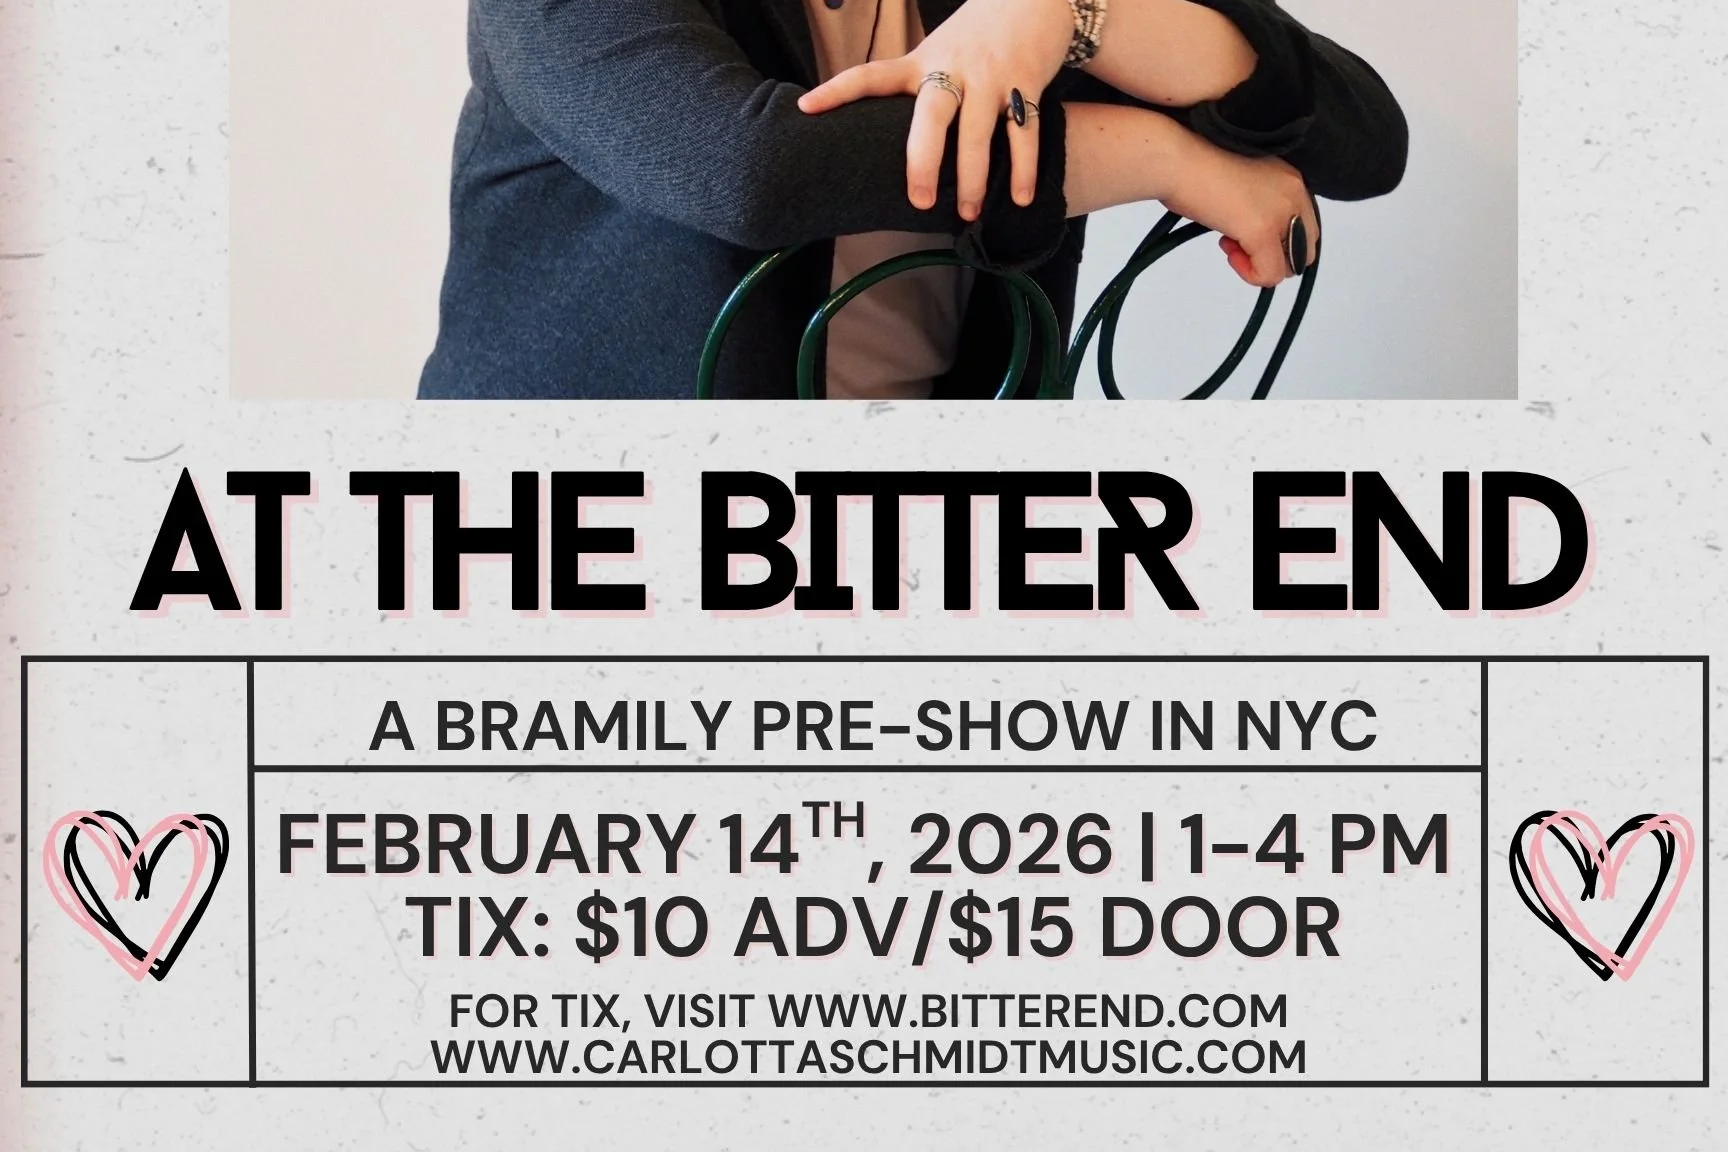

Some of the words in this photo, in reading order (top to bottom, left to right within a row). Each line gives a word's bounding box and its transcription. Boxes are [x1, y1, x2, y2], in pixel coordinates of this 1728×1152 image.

[130, 467, 310, 610] AT
[350, 471, 646, 610] THE
[701, 471, 1199, 610] BITTER
[1253, 471, 1588, 610] END
[369, 701, 414, 750] A
[438, 701, 732, 750] BRAMILY
[755, 700, 1129, 751] PRE-SHOW
[1153, 701, 1212, 750] IN
[1239, 700, 1376, 751] NYC
[280, 814, 696, 874] FEBRUARY
[911, 813, 1111, 874] 2026
[1181, 814, 1304, 873] 1-4
[1332, 814, 1446, 873] PM
[406, 897, 548, 956] TIX:
[576, 889, 708, 963] $10
[734, 889, 1073, 965] ADV/$15
[1103, 896, 1339, 957] DOOR
[451, 994, 537, 1027] FOR
[552, 994, 630, 1032] TIX,
[644, 994, 754, 1027] VISIT
[768, 994, 1286, 1027] WWW.BITTEREND.COM
[431, 1040, 1305, 1073] WWW.CARLOTTASCHMIDTMUSIC.COM
